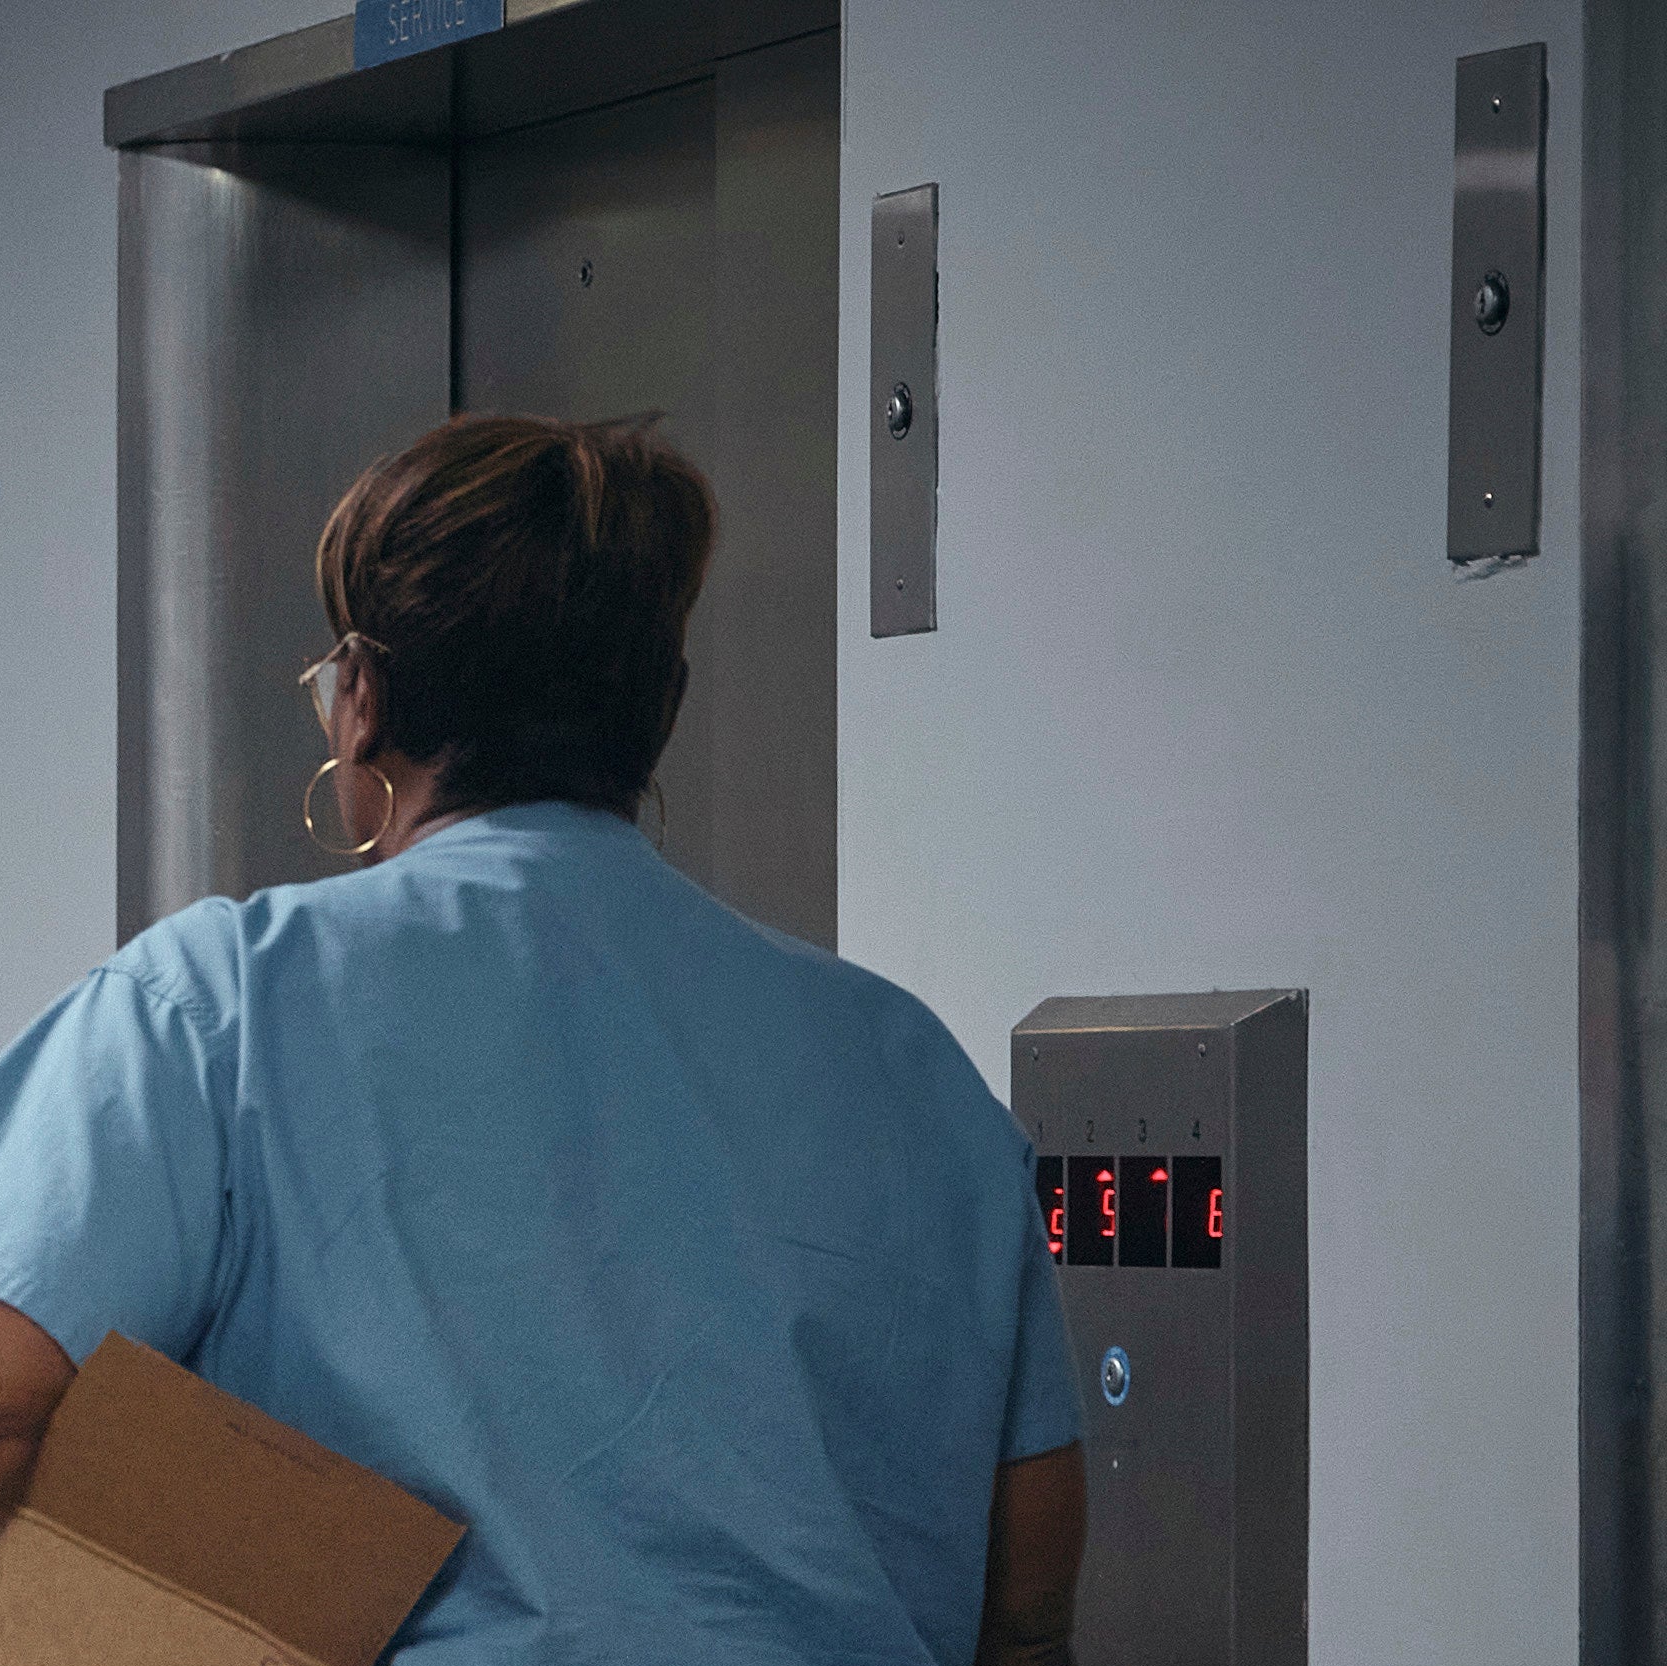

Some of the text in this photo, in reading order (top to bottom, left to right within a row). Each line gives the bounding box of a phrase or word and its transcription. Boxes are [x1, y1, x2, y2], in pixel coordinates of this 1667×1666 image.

[1037, 1118, 1202, 1143] 1 2 3 4
[1100, 1188, 1116, 1237] 5
